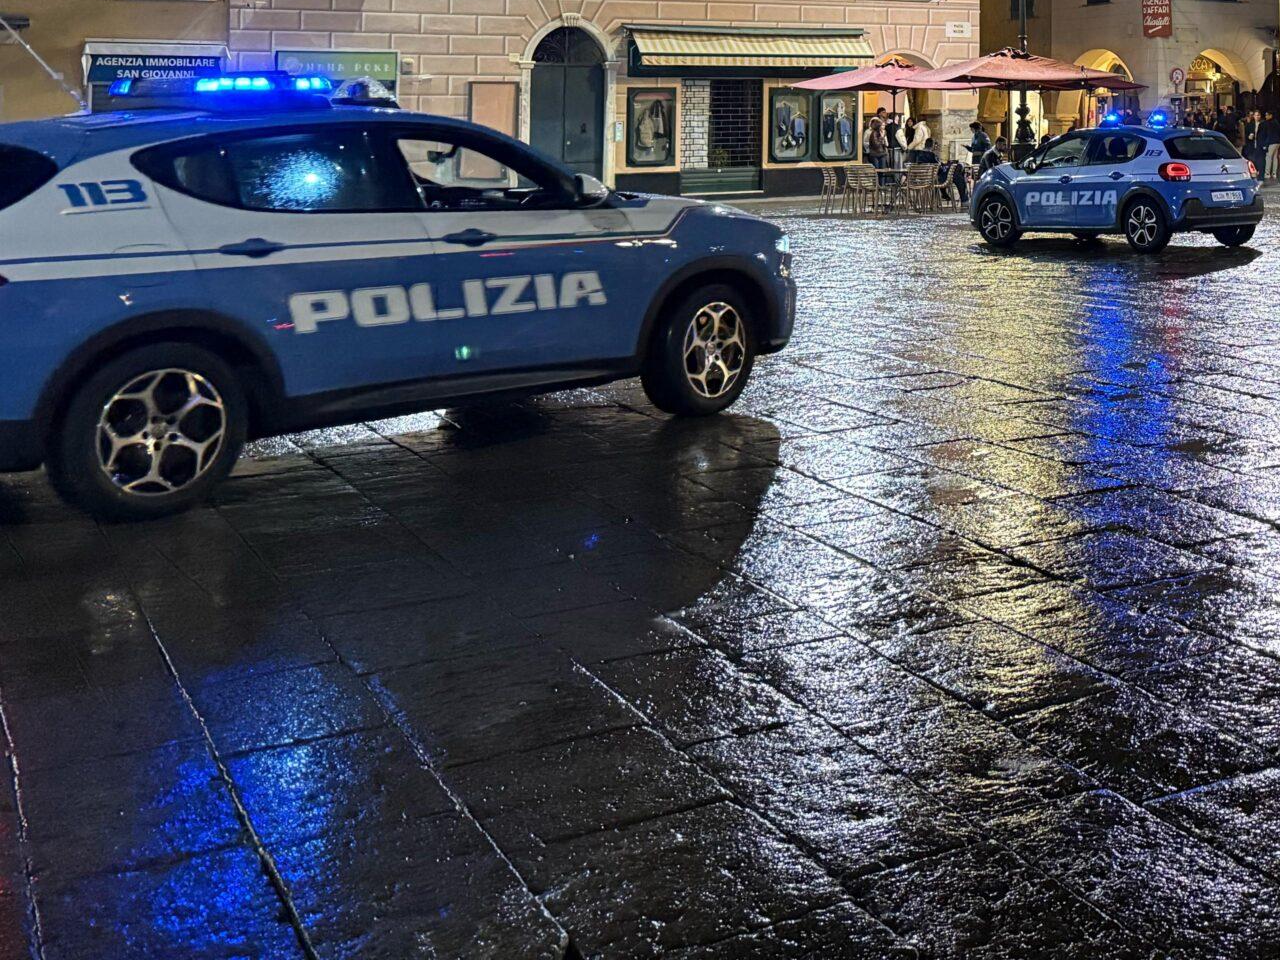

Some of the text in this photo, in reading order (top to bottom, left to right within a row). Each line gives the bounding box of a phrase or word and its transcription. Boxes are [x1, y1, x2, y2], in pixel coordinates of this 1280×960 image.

[96, 57, 215, 67] AGENZIA IMMOBILIARE
[116, 69, 195, 78] SAN GIOVANNI
[1144, 149, 1164, 157] 113
[56, 179, 148, 207] 113
[1025, 190, 1118, 206] POLIZIA
[289, 271, 608, 334] POLIZIA
